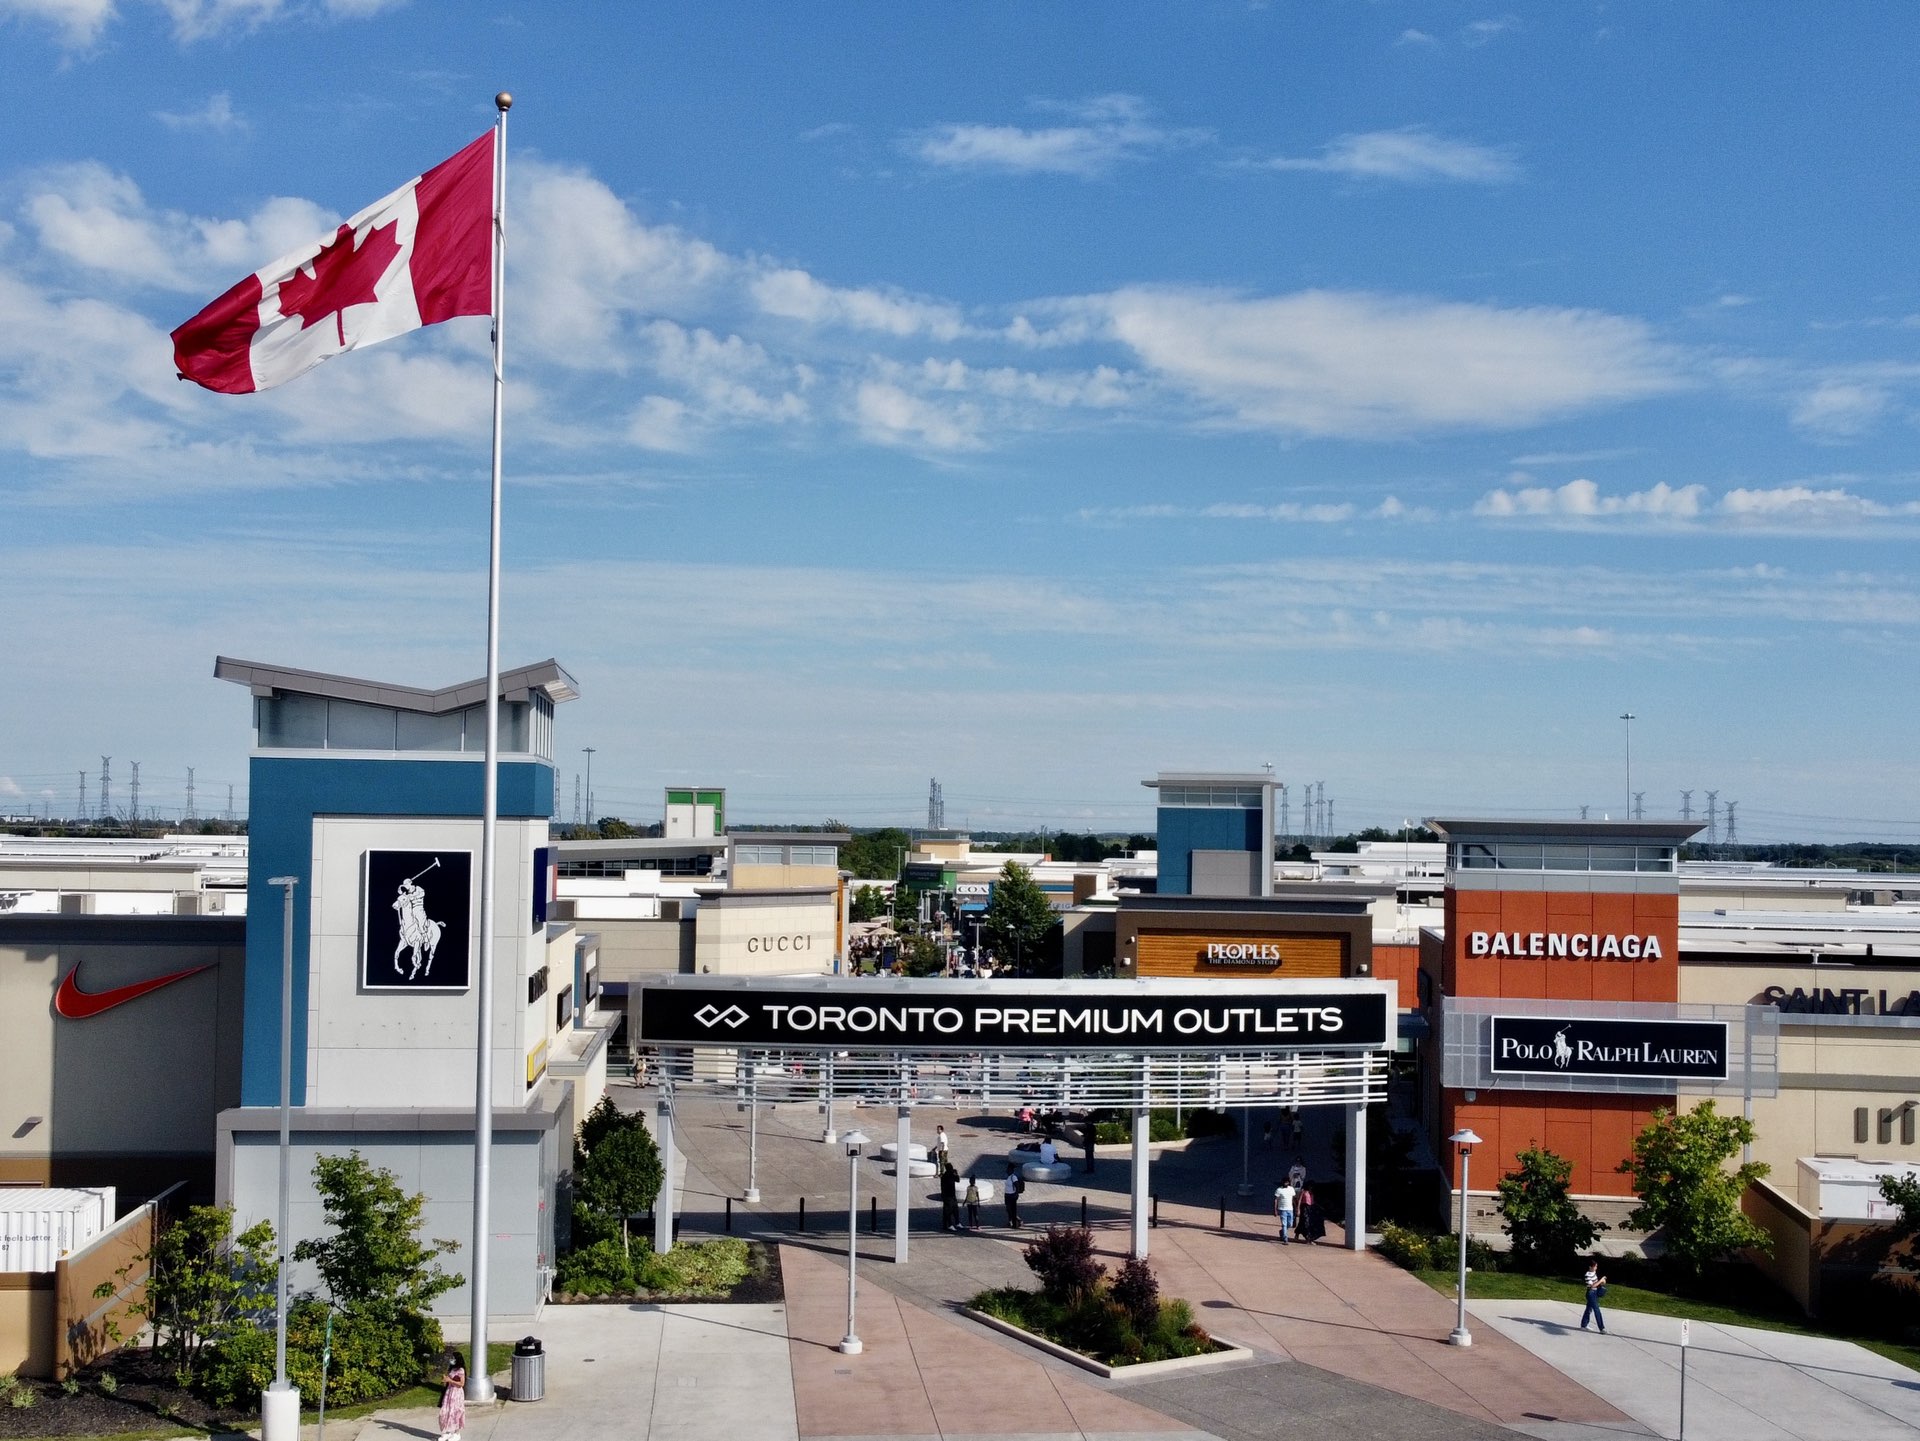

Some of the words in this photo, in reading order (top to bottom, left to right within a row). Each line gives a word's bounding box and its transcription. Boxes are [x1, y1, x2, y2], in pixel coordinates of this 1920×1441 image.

[747, 934, 811, 953] GUCCI
[1207, 943, 1280, 959] PEOPLES
[1471, 931, 1662, 959] BALENCIAGA
[1763, 985, 1869, 1015] SAINT
[762, 1005, 964, 1033] TORONTO
[975, 1007, 1163, 1034] PREMIUM
[1173, 1006, 1344, 1034] OUTLETS
